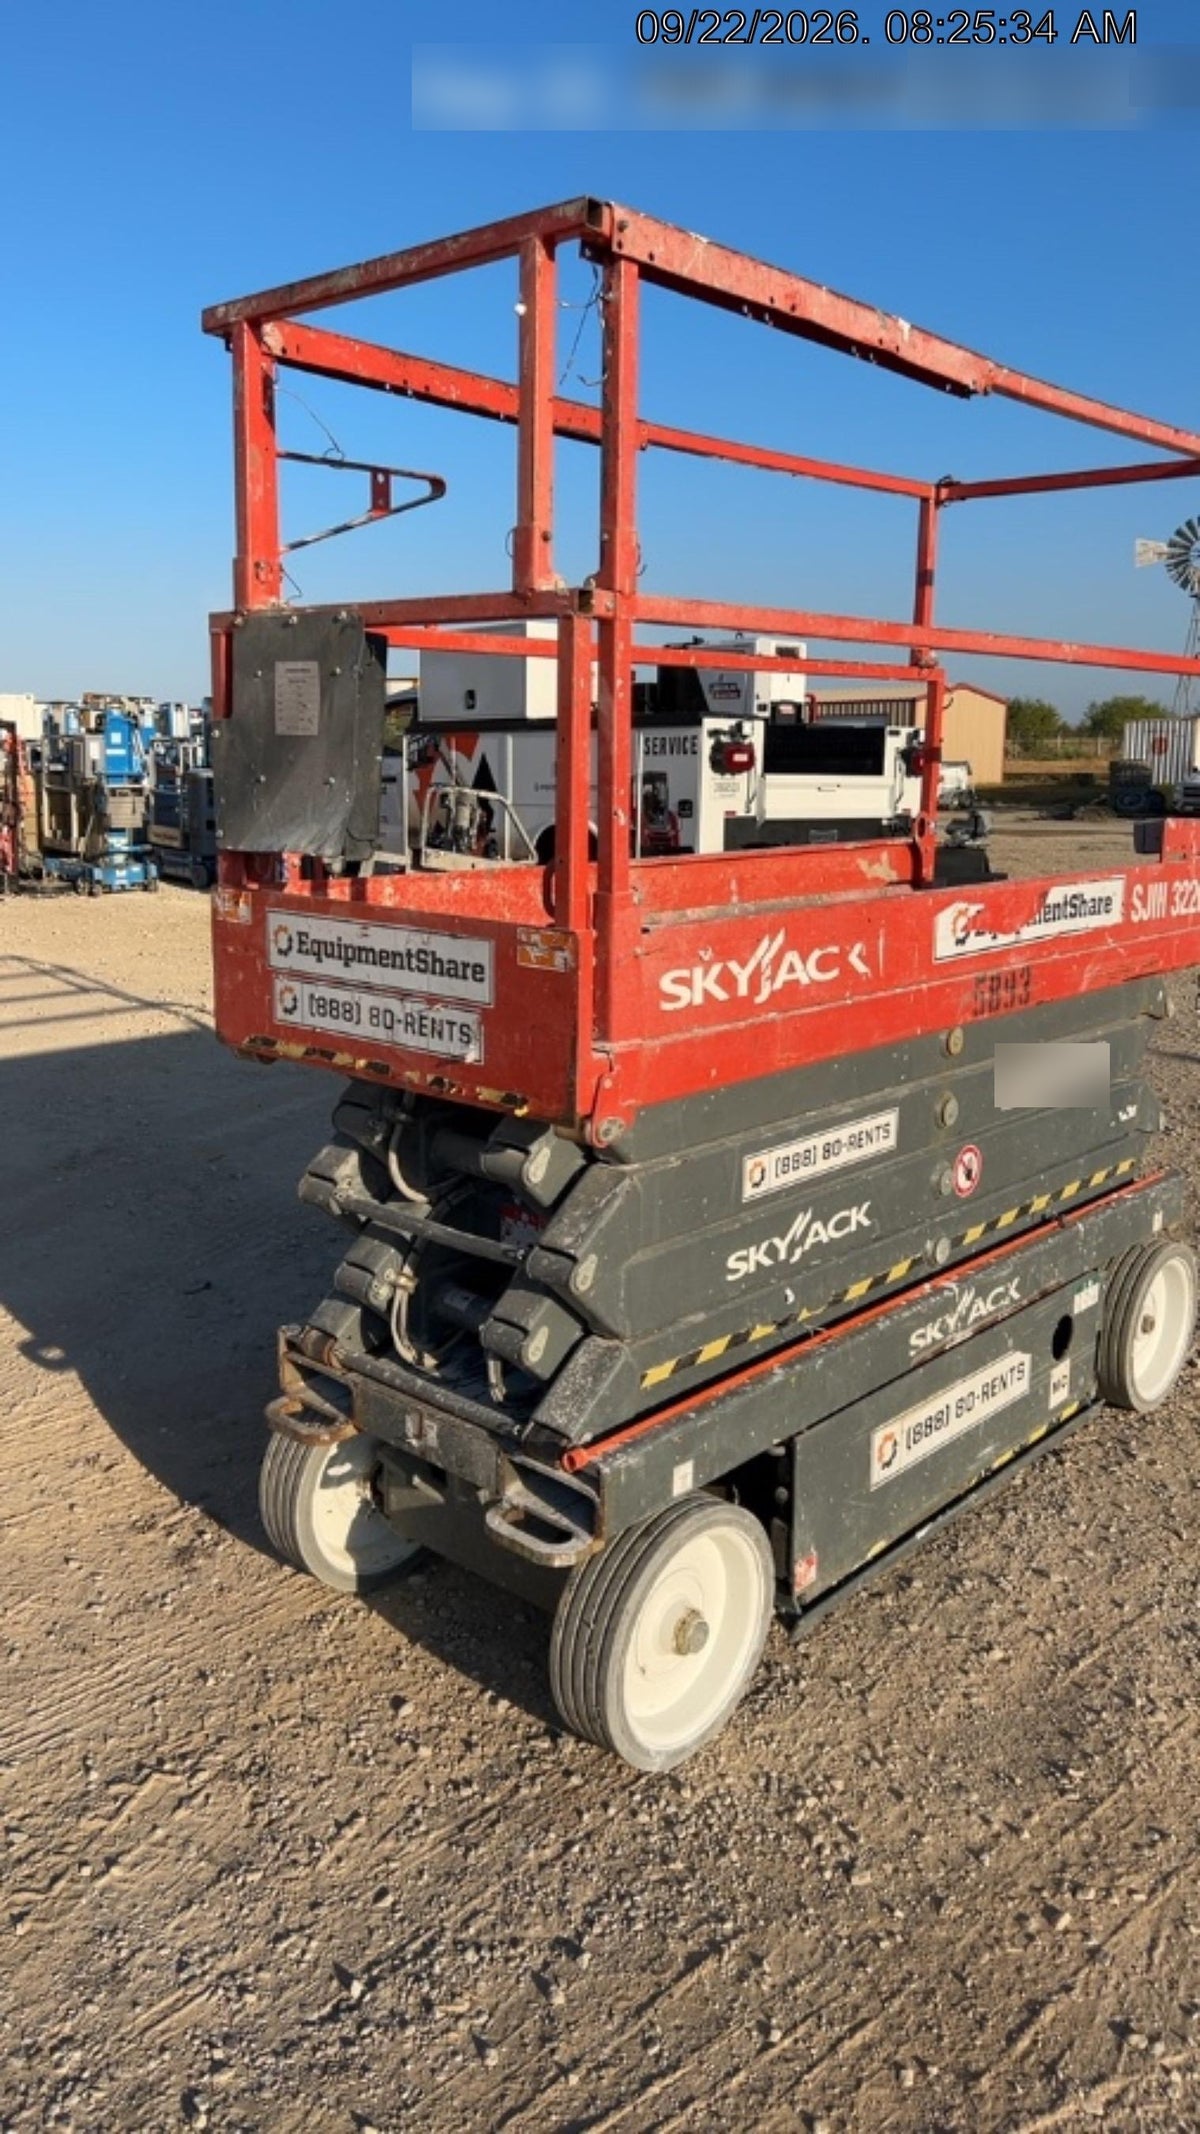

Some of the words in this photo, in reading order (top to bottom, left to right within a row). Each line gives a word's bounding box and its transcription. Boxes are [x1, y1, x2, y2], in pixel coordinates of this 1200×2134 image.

[643, 736, 698, 756] SERVICE
[296, 931, 486, 983] EquipmentShare
[725, 1200, 872, 1282] SKYJACK
